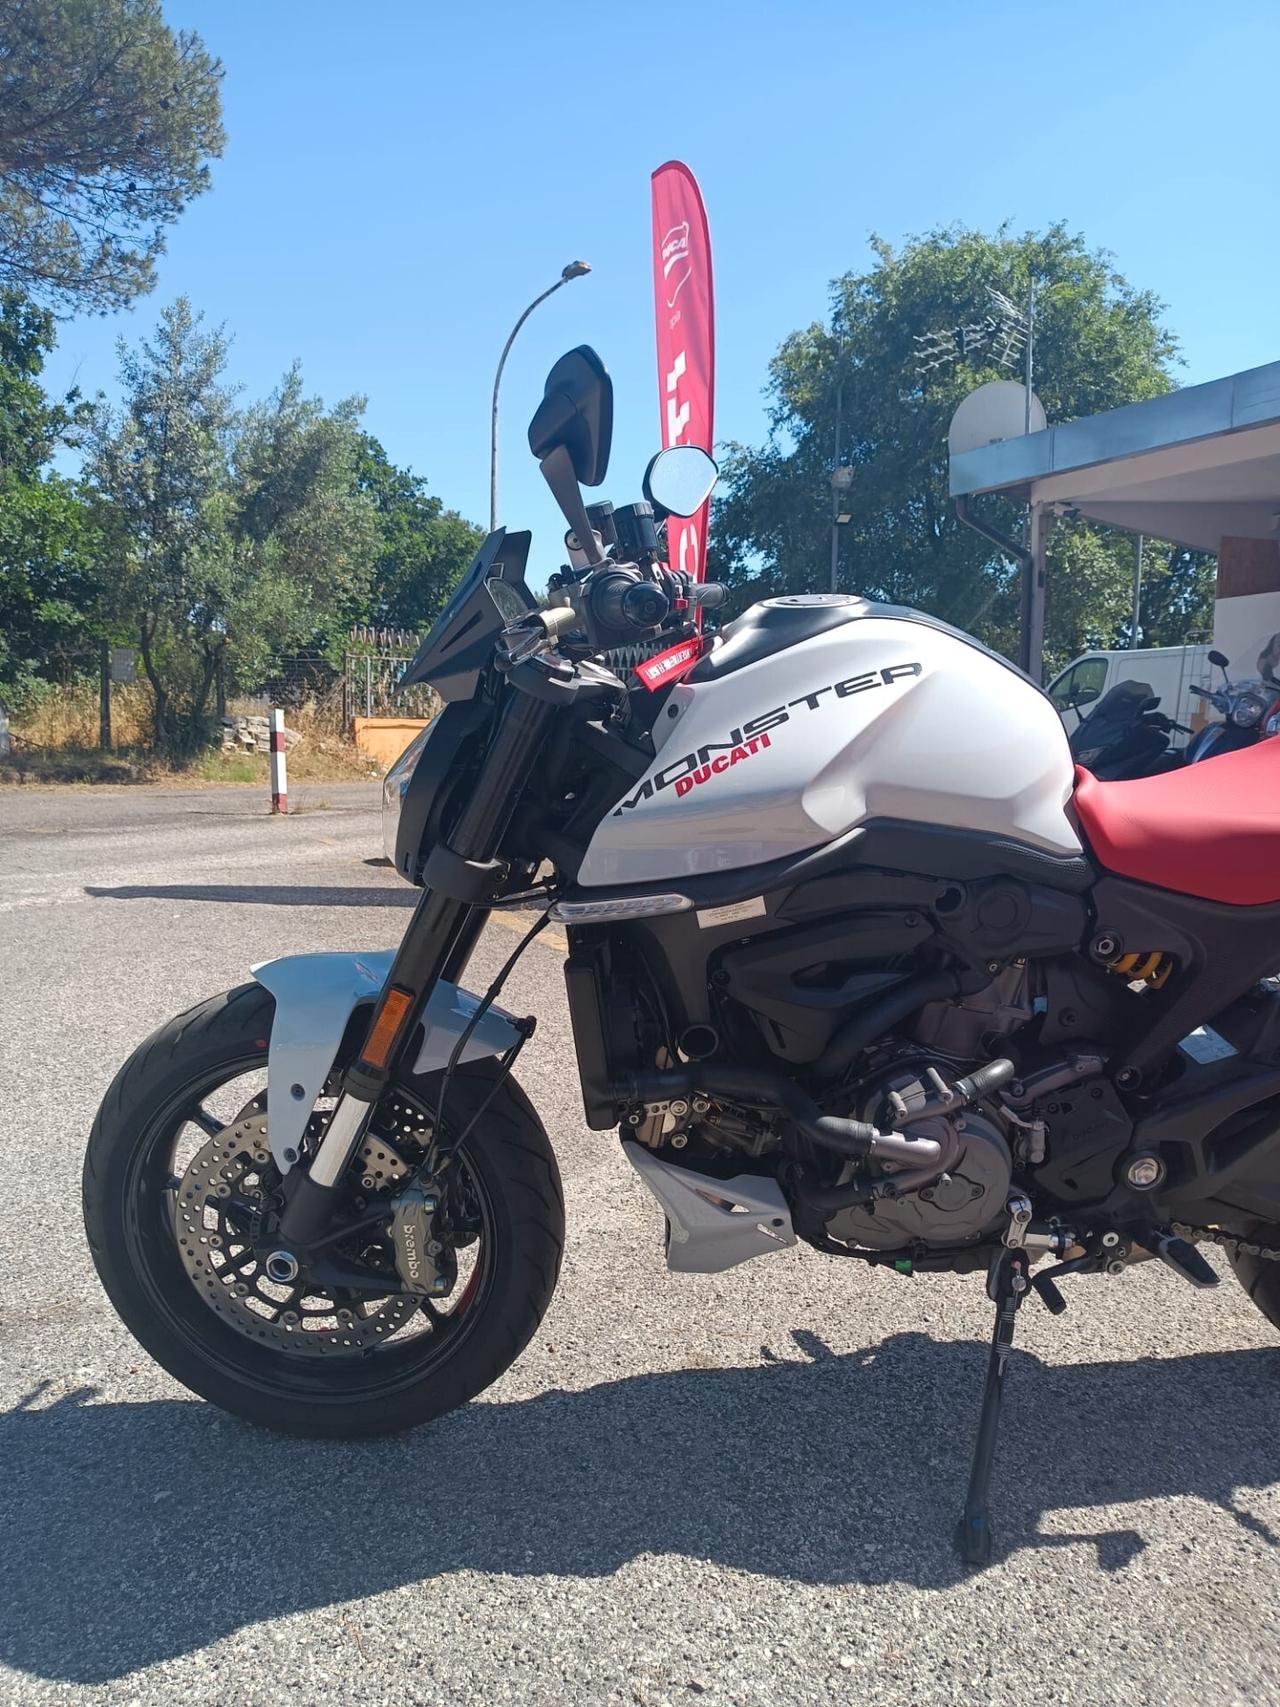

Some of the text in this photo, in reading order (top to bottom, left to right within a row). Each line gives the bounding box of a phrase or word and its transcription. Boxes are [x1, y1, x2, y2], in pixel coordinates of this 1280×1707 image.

[613, 663, 922, 816] MONSTER
[675, 733, 771, 797] DUCATI
[404, 1225, 420, 1278] brembo
